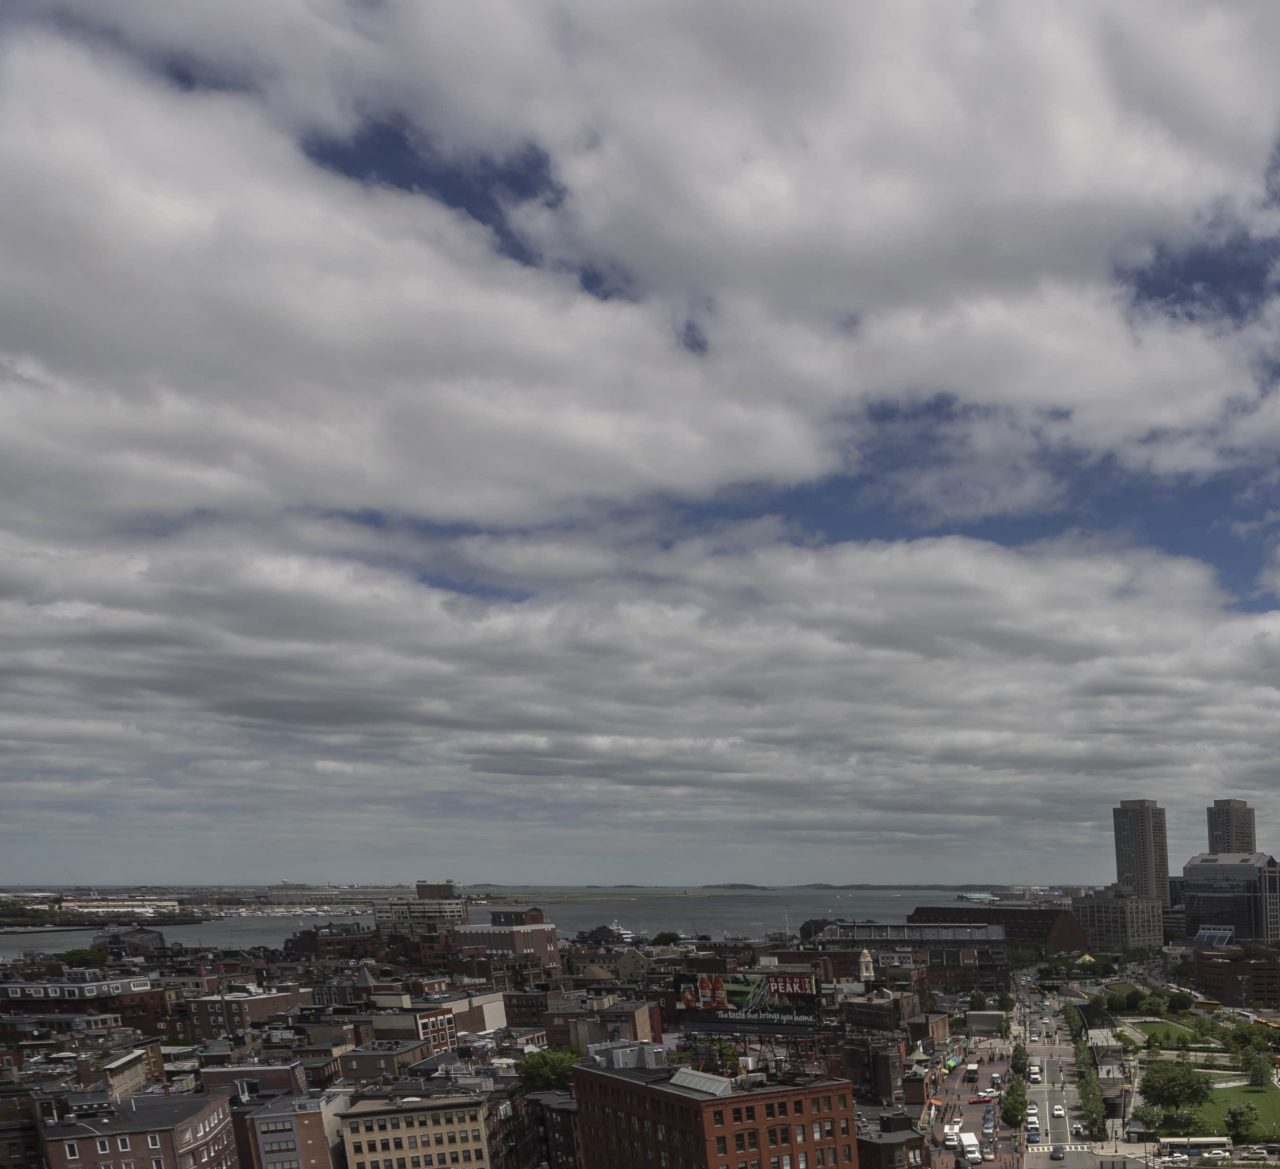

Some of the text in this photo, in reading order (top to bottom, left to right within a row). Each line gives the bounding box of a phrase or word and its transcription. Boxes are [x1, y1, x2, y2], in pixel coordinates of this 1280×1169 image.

[770, 982, 801, 993] PEAK
[716, 1010, 815, 1024] The taste that brings you home.
